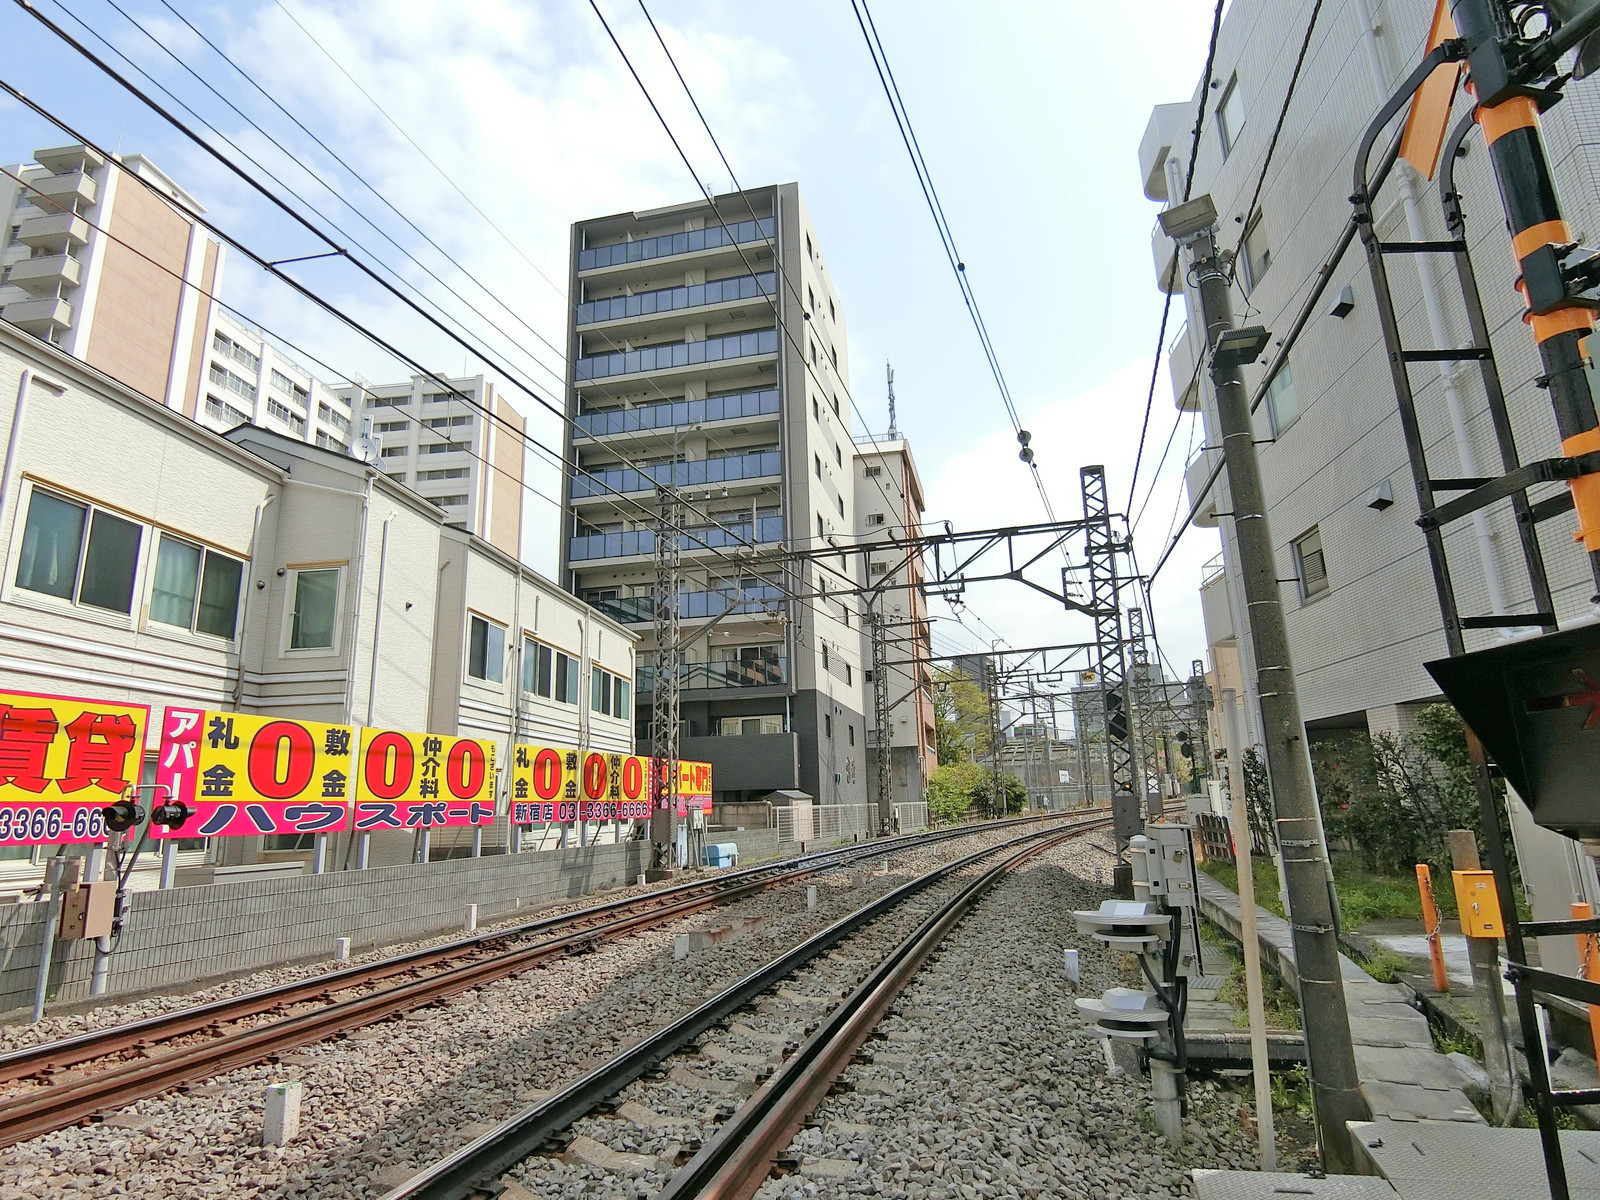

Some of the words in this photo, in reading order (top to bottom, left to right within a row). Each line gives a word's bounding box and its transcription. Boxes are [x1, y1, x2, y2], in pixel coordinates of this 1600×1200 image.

[162, 711, 200, 834] アパー
[201, 716, 239, 797] 礼金
[247, 720, 315, 799] 0
[322, 729, 350, 798] 敷金
[364, 731, 414, 799] 0
[419, 736, 442, 799] 仲介料
[446, 739, 485, 799] 0
[514, 747, 530, 798] 礼金
[533, 748, 562, 800] 0
[565, 752, 577, 798] 敷金
[584, 752, 607, 800] 0
[610, 756, 620, 799] 仲介料
[623, 757, 643, 800] 0
[198, 802, 494, 836] ハウスポート
[514, 801, 554, 822] 新宿店
